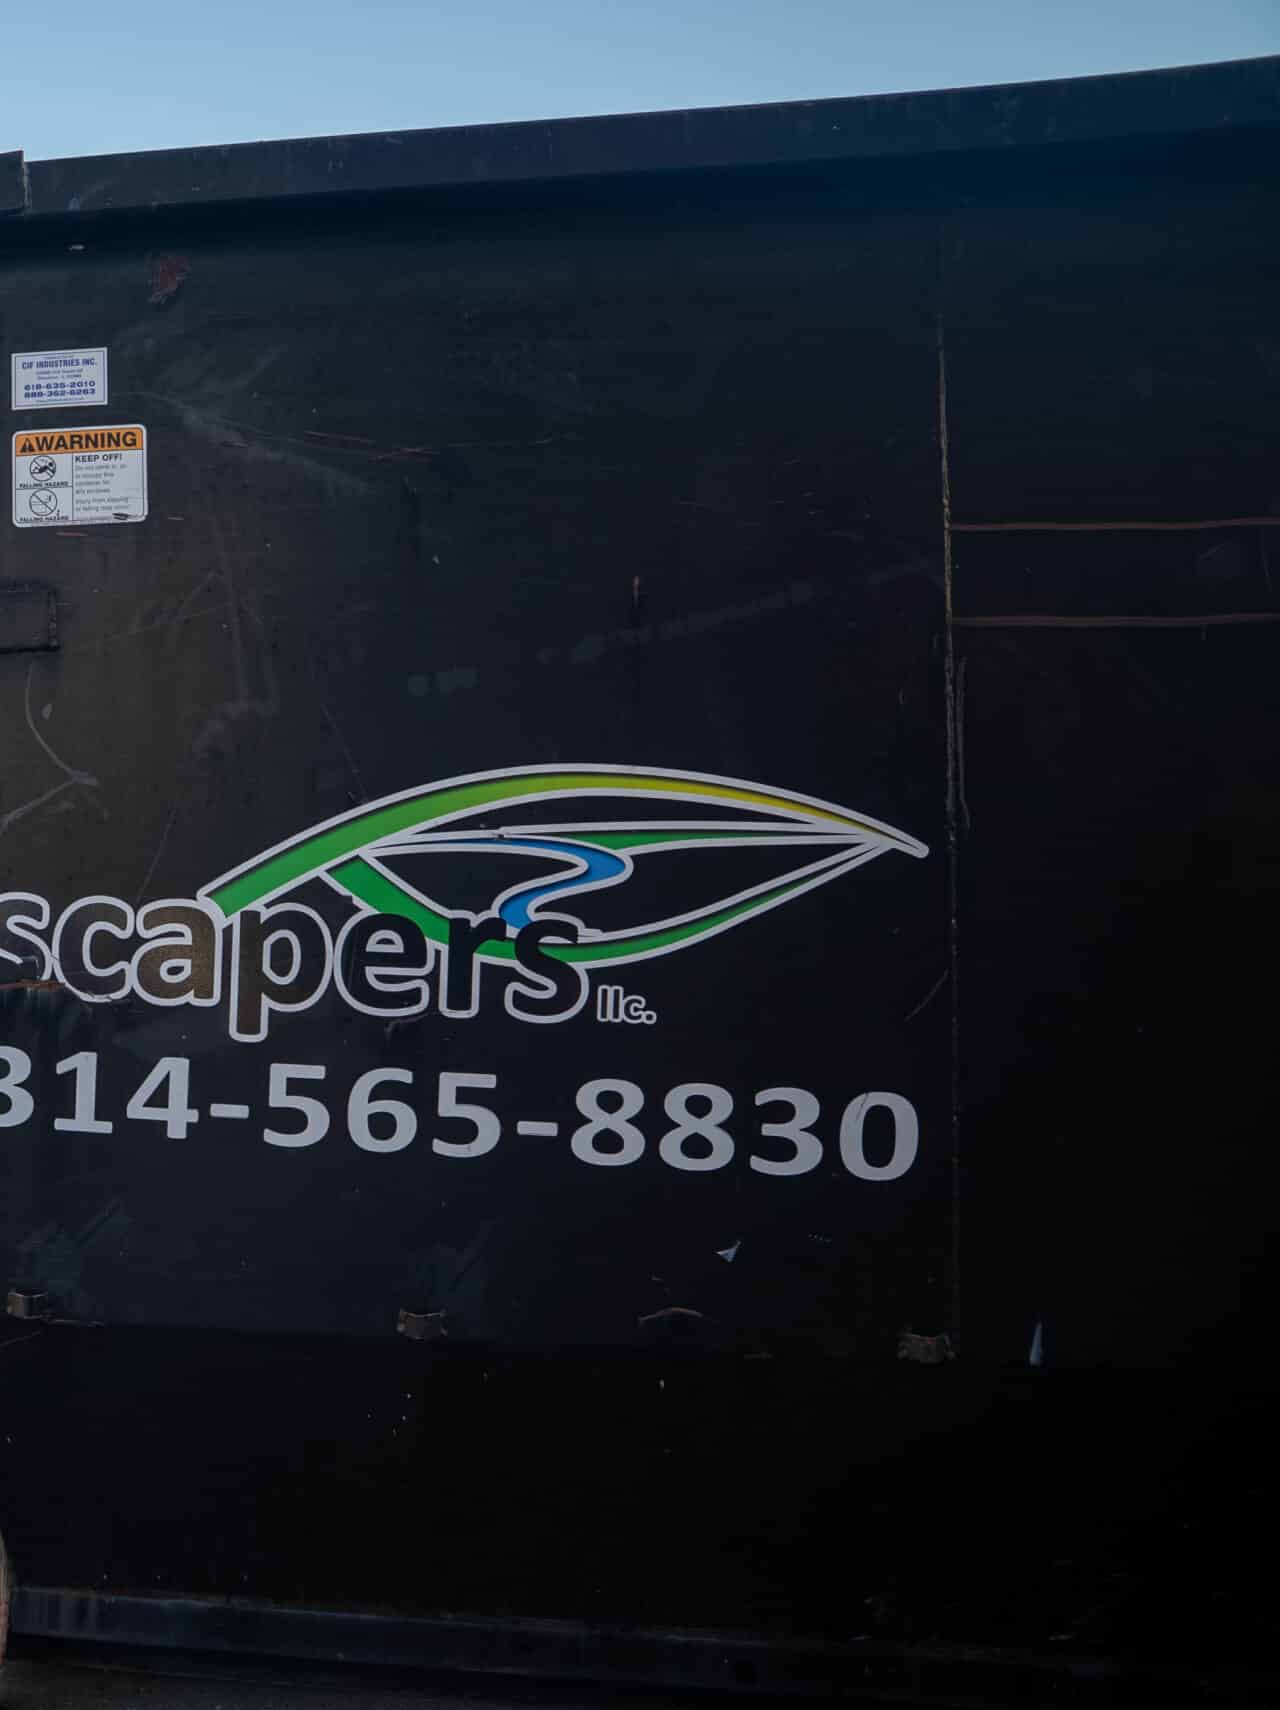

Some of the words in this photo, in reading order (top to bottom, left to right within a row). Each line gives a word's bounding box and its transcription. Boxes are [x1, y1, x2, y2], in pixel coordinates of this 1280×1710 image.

[36, 359, 80, 369] INDUSTRIES
[35, 432, 137, 451] WARNING
[75, 454, 100, 463] KEEP
[102, 453, 122, 462] OFF!
